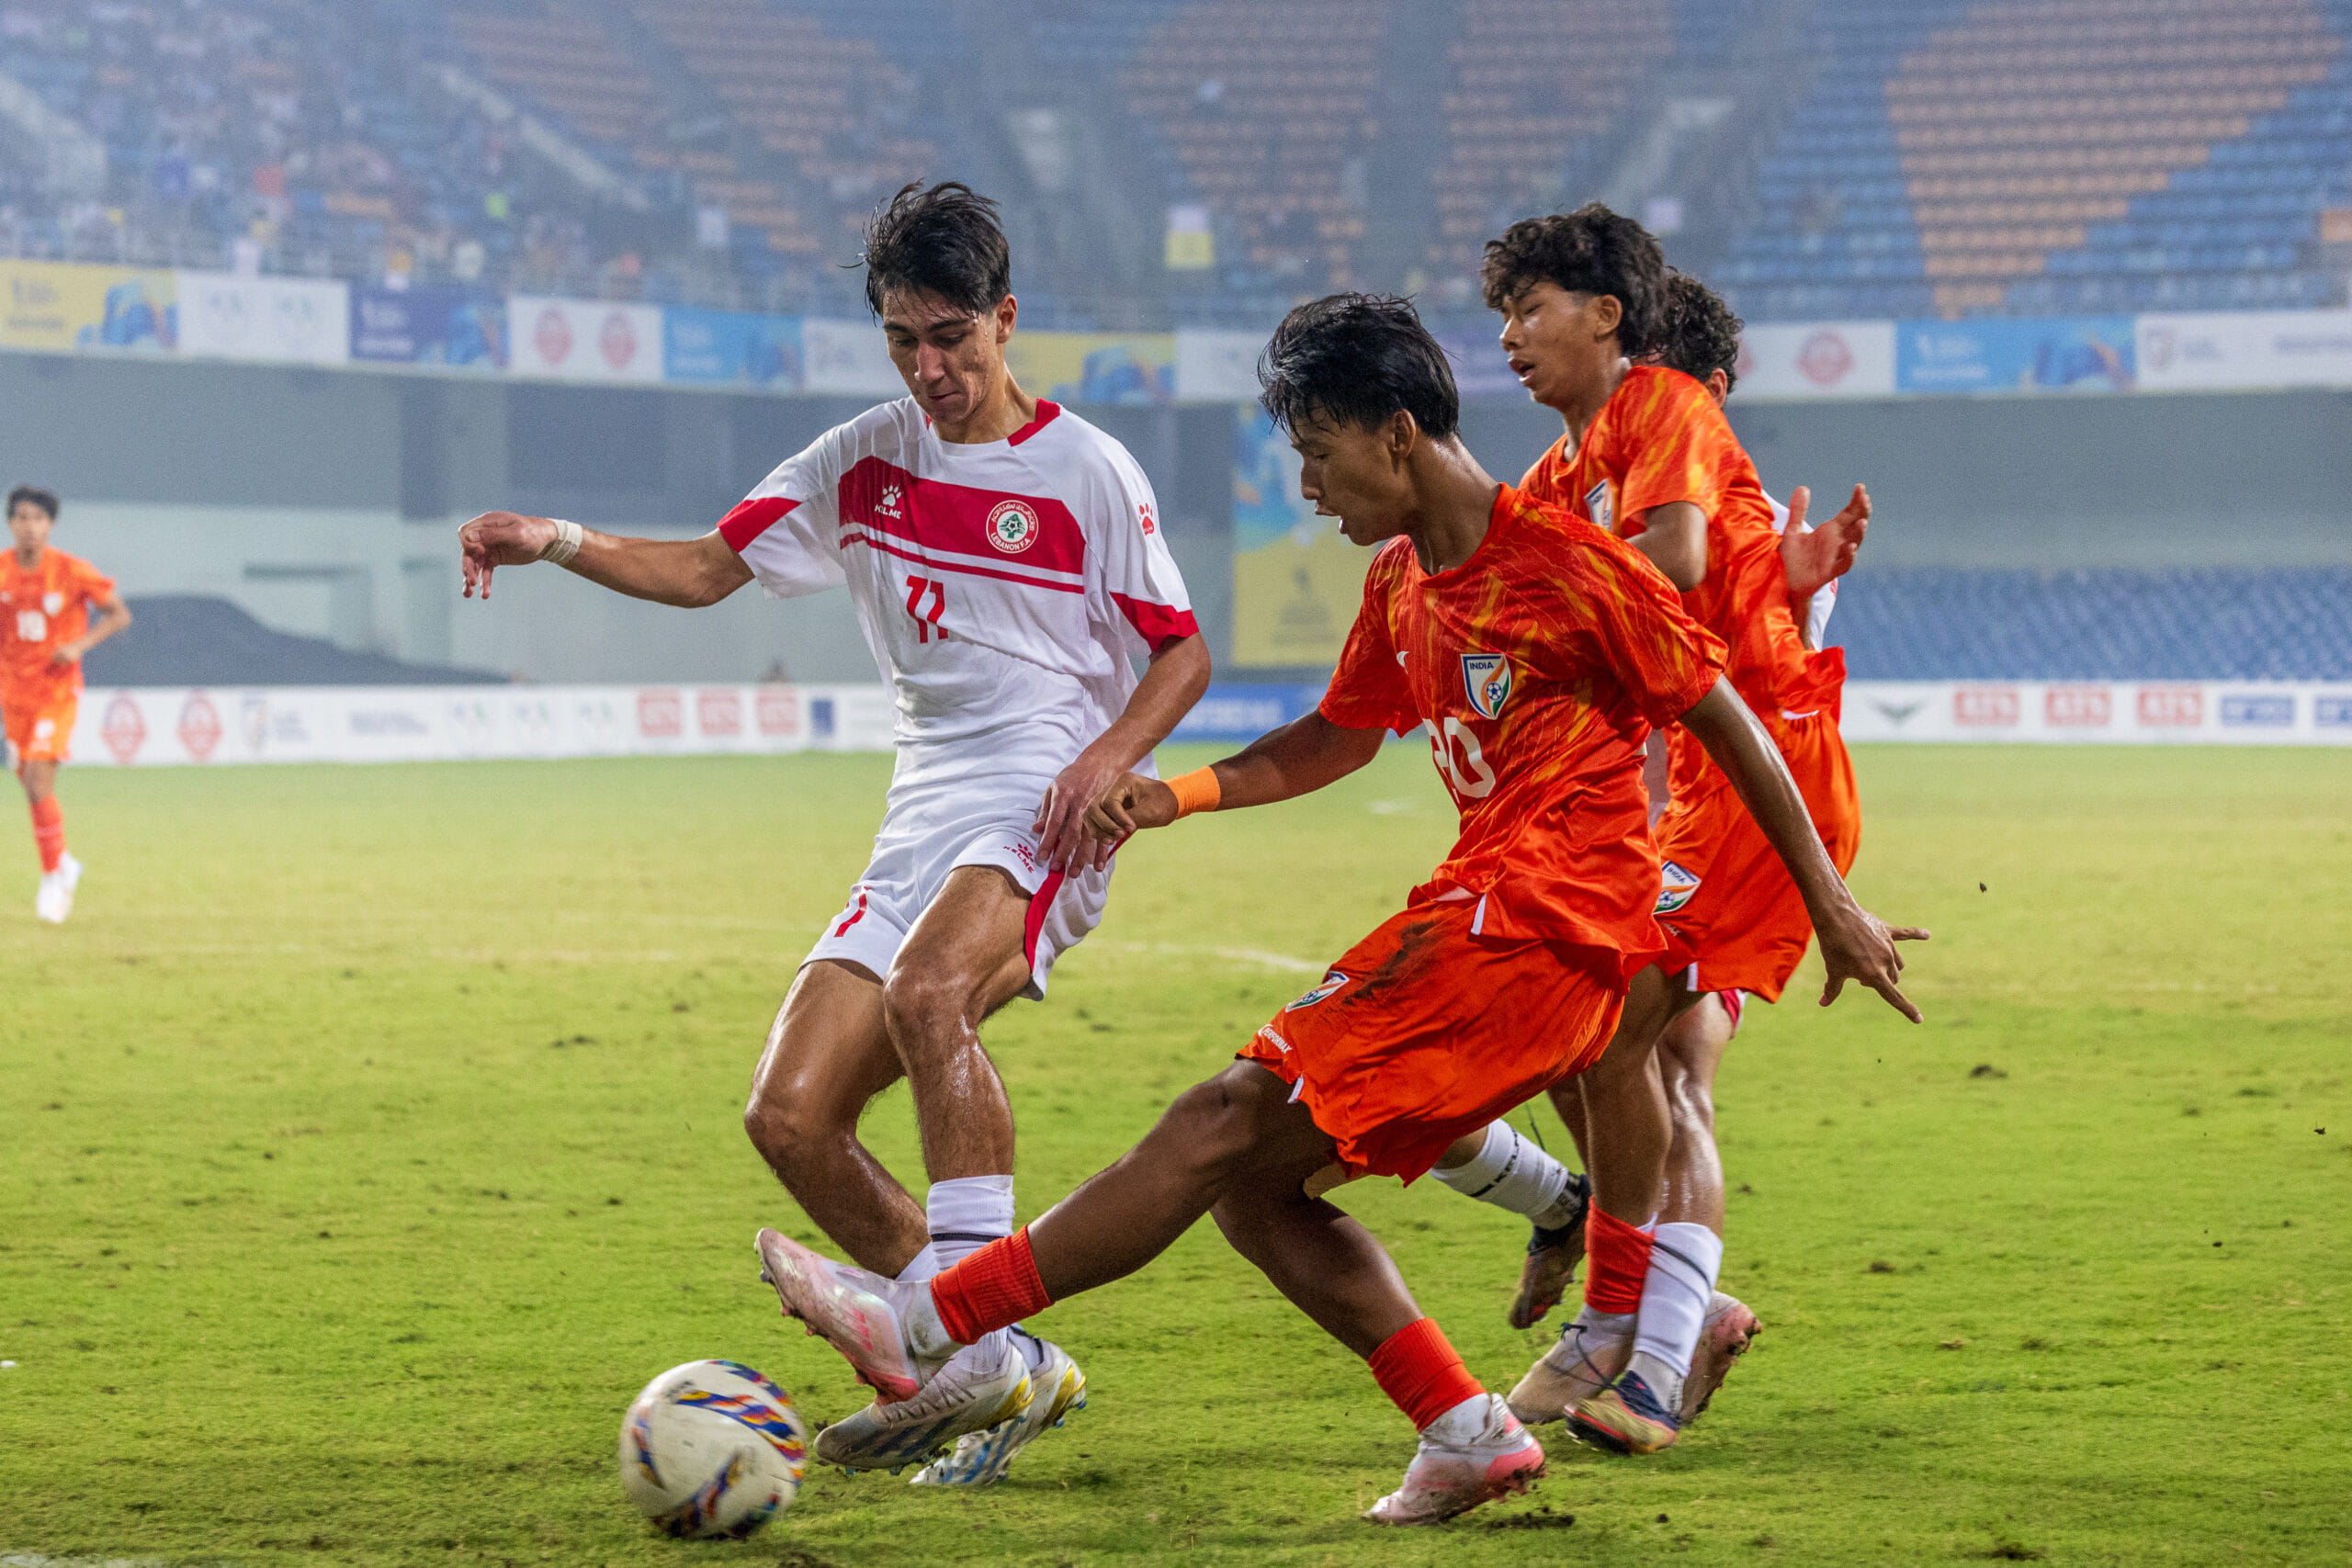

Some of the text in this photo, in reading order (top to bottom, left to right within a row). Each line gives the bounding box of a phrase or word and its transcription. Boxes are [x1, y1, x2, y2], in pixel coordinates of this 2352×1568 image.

[990, 532, 1020, 551] LEBANON
[1469, 660, 1495, 671] INDIA
[1002, 844, 1035, 874] KELME
